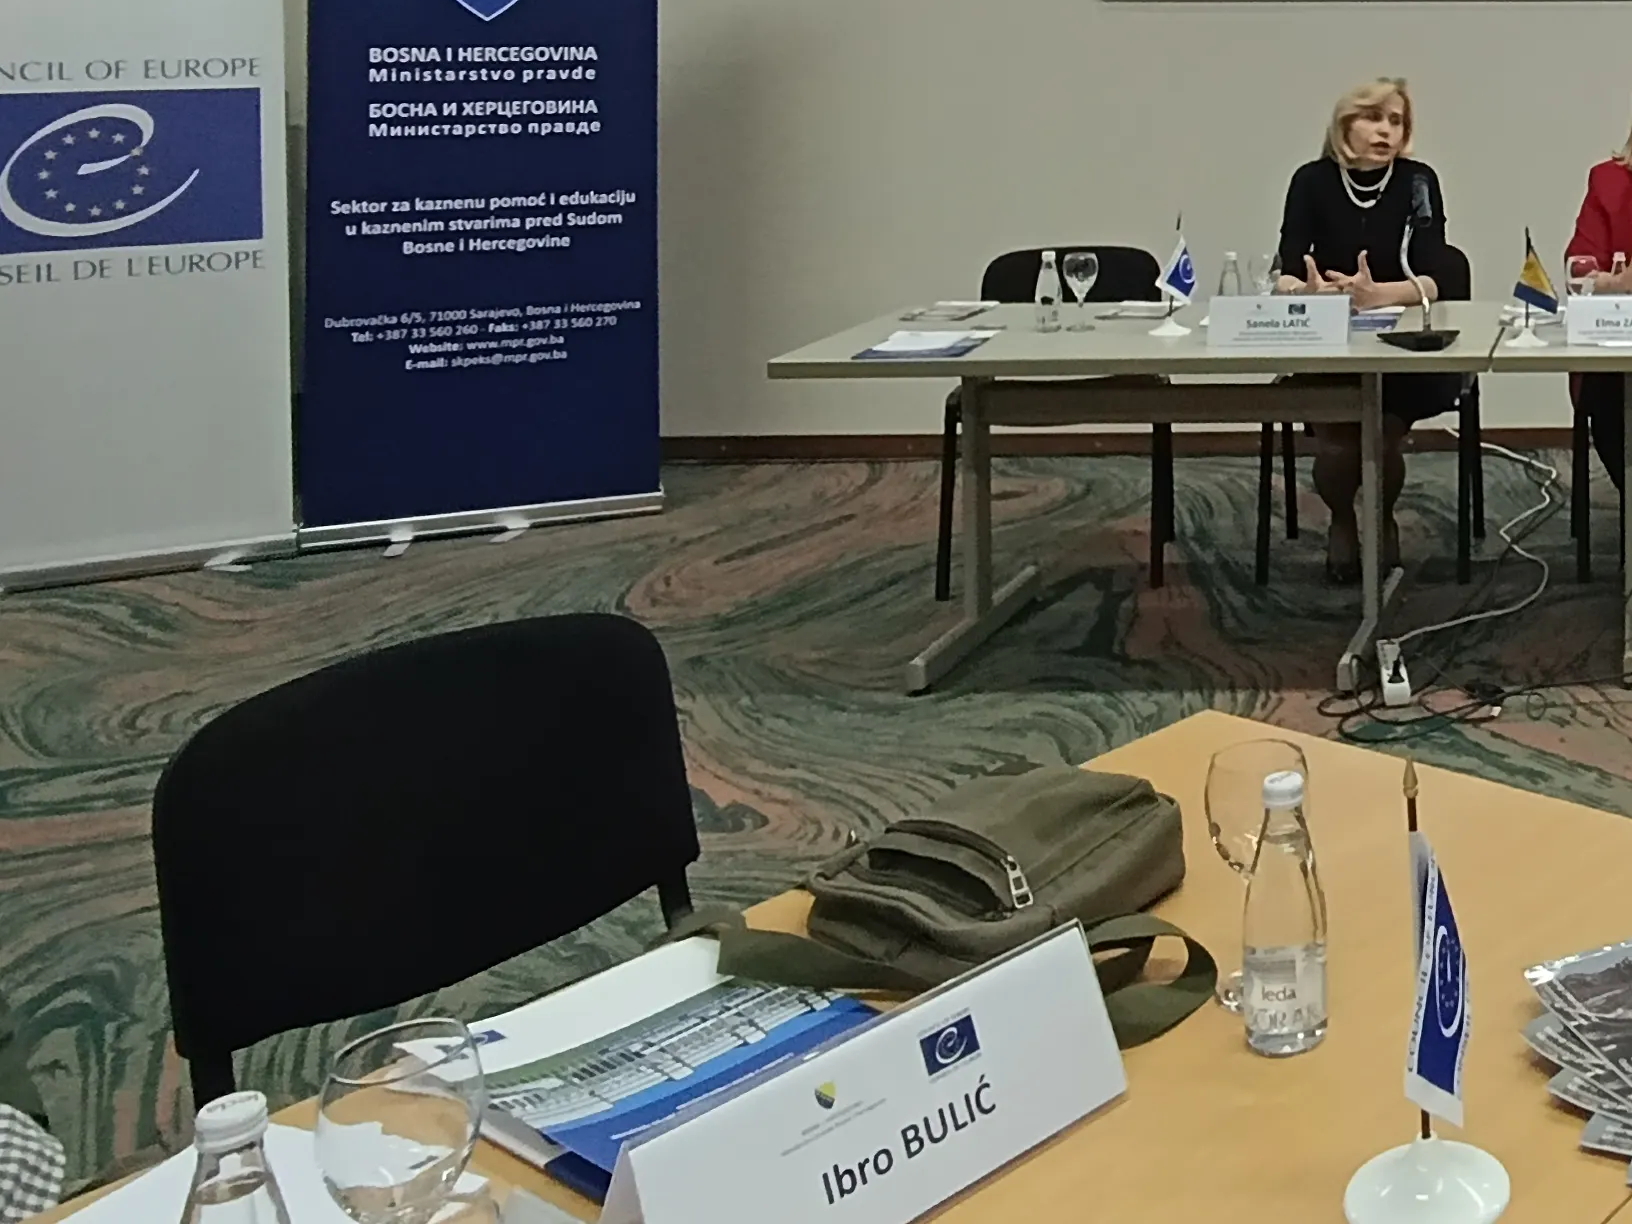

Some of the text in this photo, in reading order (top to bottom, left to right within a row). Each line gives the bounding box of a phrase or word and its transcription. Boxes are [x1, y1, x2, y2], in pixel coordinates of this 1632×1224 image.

[369, 45, 598, 63] BOSNA I HERCEGOVINA
[0, 57, 263, 81] NCIL OF EUROPE
[369, 66, 597, 83] Ministarstvo pravde
[369, 99, 598, 118] БОСНА И ХЕРЦЕГОВИНА
[369, 120, 601, 137] Министарство правде
[331, 199, 387, 215] Sektor
[391, 201, 410, 212] za
[415, 196, 485, 211] kaznenu
[490, 192, 546, 211] pomoć
[559, 190, 636, 207] edukaciju
[345, 211, 623, 236] u kaznenim stvarima pred Sudom
[403, 240, 454, 255] Bosne
[468, 235, 571, 253] Hercegovine
[0, 249, 266, 286] SEIL DE L'EUROPE
[429, 310, 467, 322] 71000
[526, 304, 561, 316] Bosna
[570, 300, 641, 314] Hercegovina
[376, 328, 407, 341] +387
[411, 327, 426, 339] 33
[429, 326, 452, 338] 560
[455, 324, 478, 336] 260
[522, 319, 550, 332] +387
[554, 318, 568, 329] 33
[595, 315, 617, 327] 270
[821, 1148, 894, 1206] Ibro
[900, 1073, 997, 1160] BULIĆ
